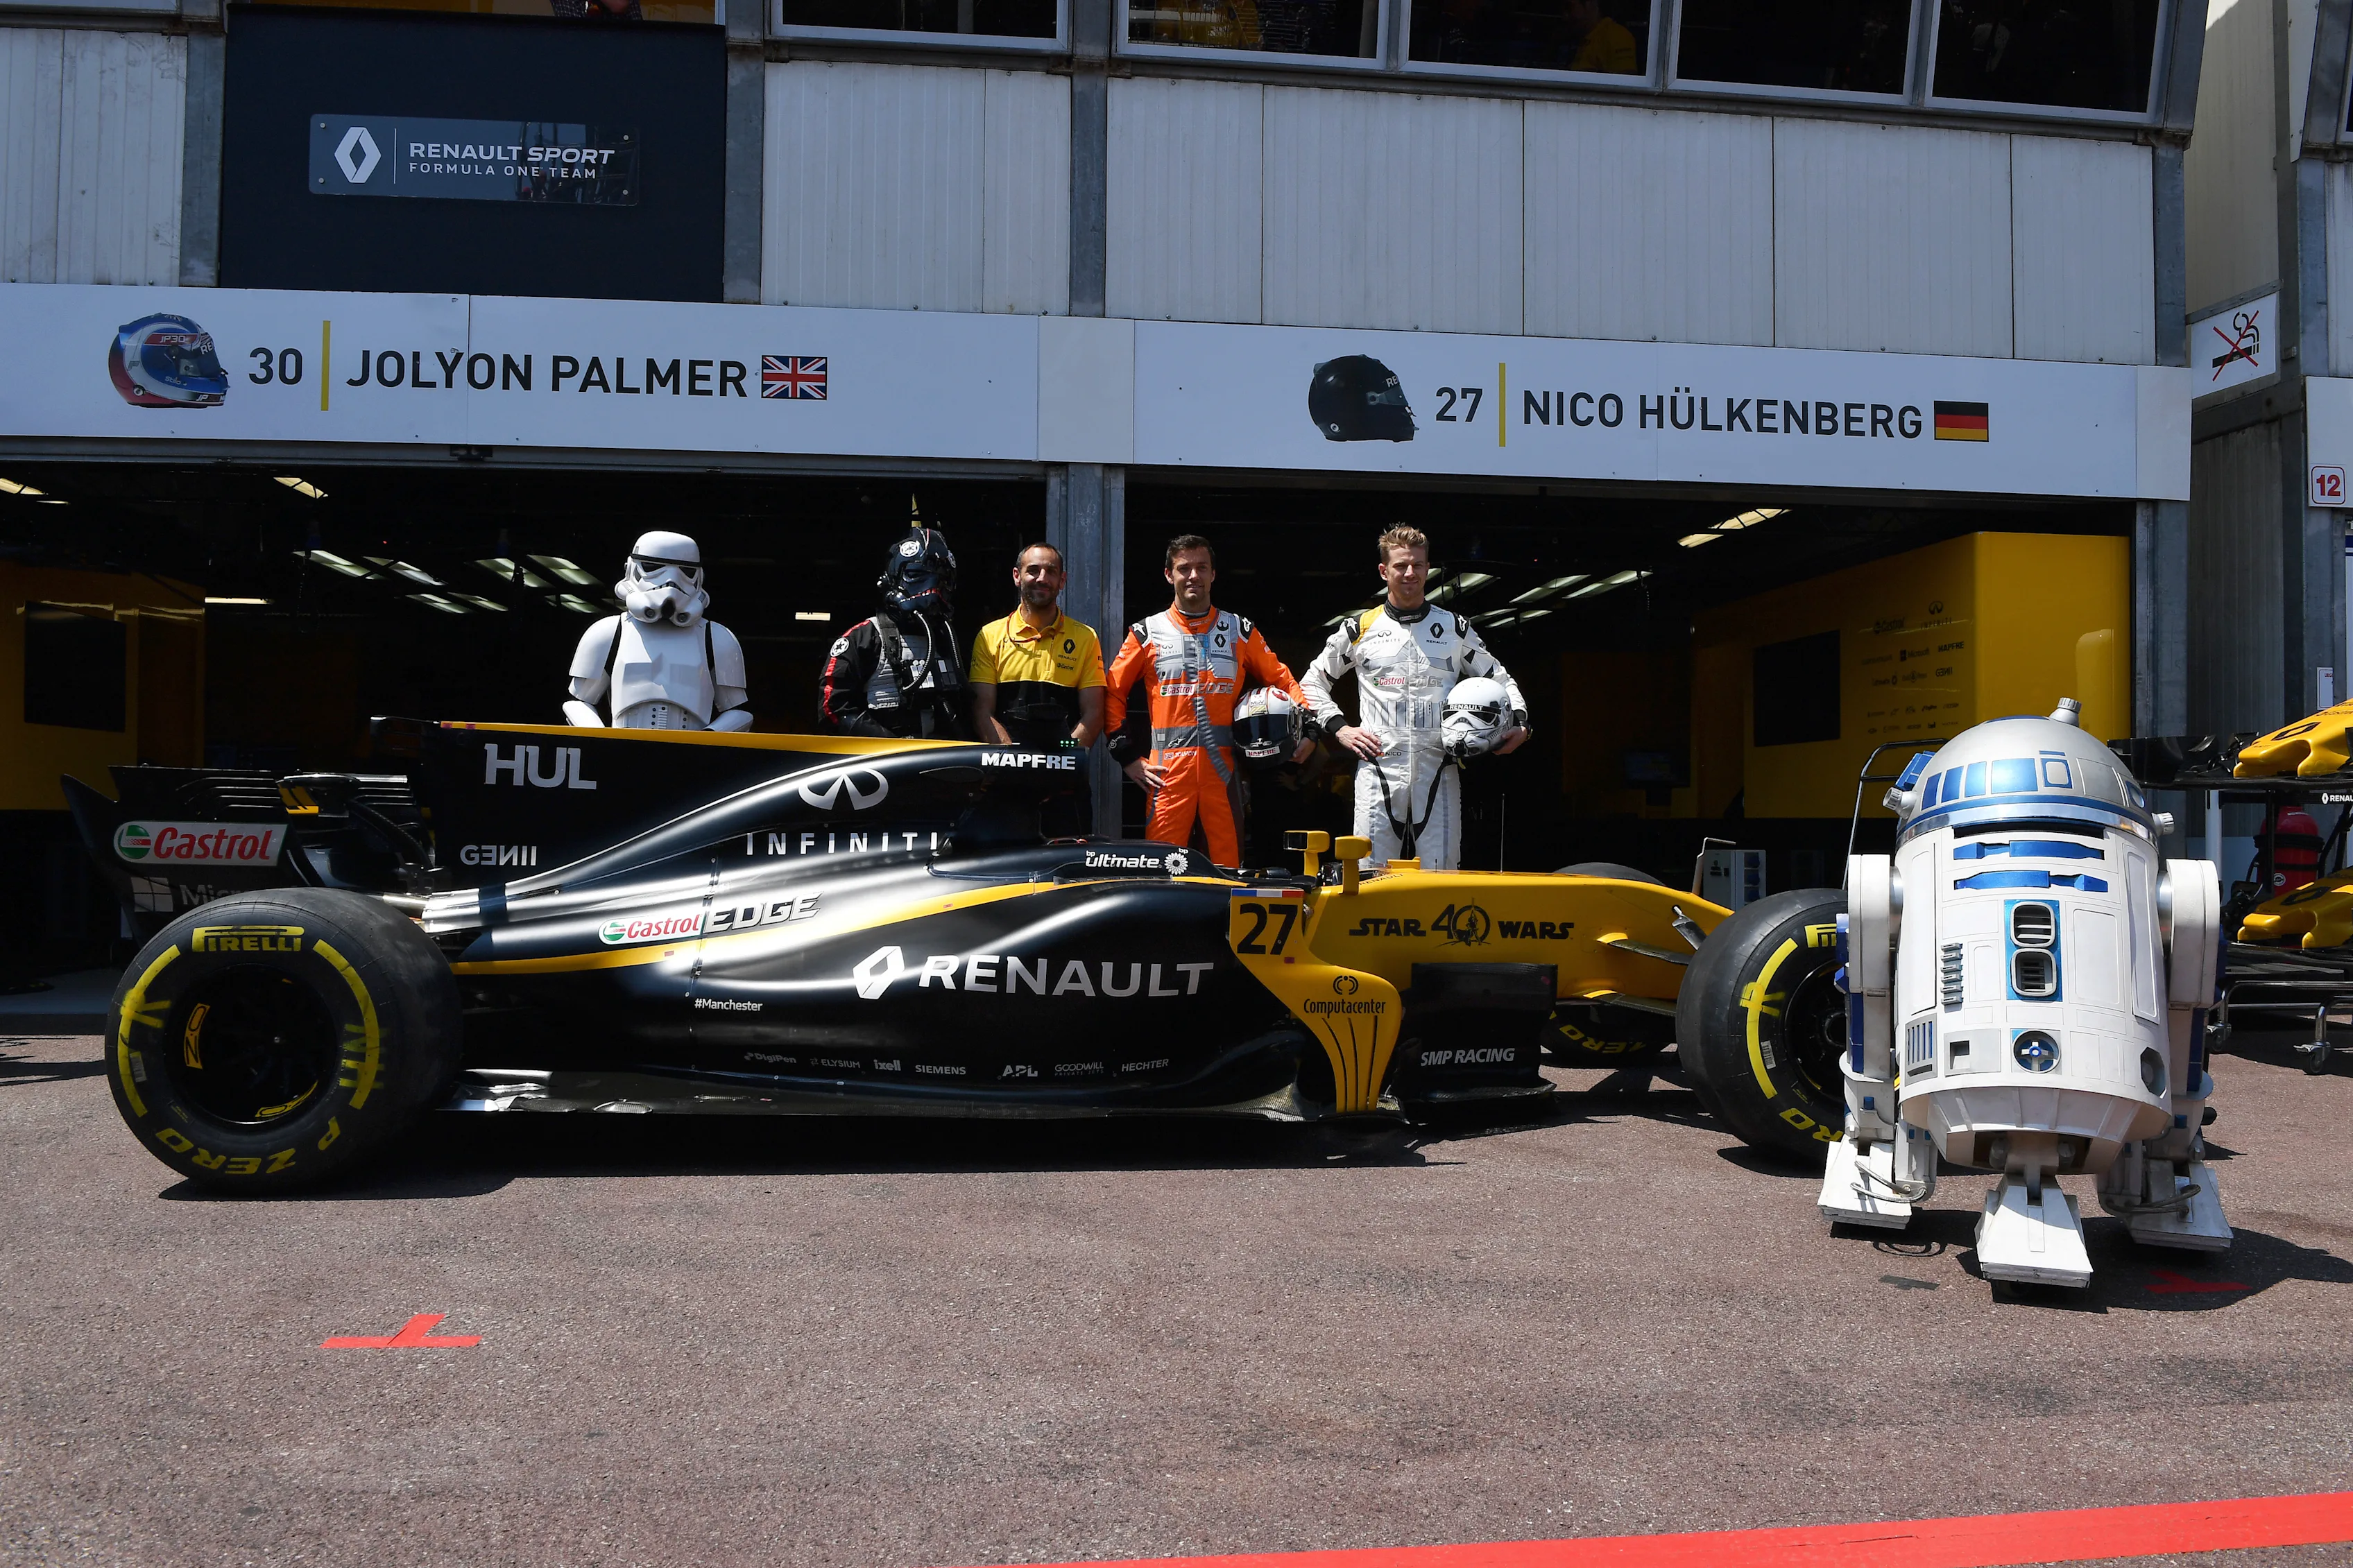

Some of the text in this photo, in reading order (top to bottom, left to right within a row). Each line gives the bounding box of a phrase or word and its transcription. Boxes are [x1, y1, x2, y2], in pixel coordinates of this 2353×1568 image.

[409, 142, 615, 164] RENAULT SPORT
[409, 162, 596, 180] FORMULA ONE TEAM
[160, 335, 186, 343] JP30
[249, 347, 302, 386] 30
[346, 351, 748, 398] JOLYON PALMER
[1436, 386, 1483, 423] 27
[1523, 386, 1922, 440] NICO HÜLKENBERG
[2316, 474, 2341, 497] 12
[1938, 641, 1964, 653] MAPFRE
[1167, 682, 1234, 694] Castrol EDGE
[1379, 676, 1405, 687] Castrol
[1449, 703, 1484, 712] RENAULT
[484, 743, 597, 790] HUL
[981, 752, 1076, 770] MAPFRE
[153, 827, 273, 861] Castrol
[746, 832, 938, 856] INFINITI
[1085, 854, 1160, 868] ultimate
[627, 890, 824, 939] Castrol EDGE
[1237, 903, 1299, 956] 27
[1349, 917, 1427, 937] STAR
[1498, 921, 1575, 940] WARS
[191, 925, 305, 953] PIRELLI
[918, 954, 1215, 998] RENAULT
[694, 997, 763, 1012] #Manchester
[1303, 998, 1386, 1019] Computacenter
[755, 1052, 797, 1064] DigiPen
[821, 1058, 860, 1069] ELYSIUM
[873, 1059, 902, 1071] ixell
[1054, 1062, 1104, 1072] GOODWILL
[1121, 1058, 1170, 1072] HECHTER
[1421, 1048, 1516, 1067] SMP RACING
[914, 1065, 966, 1076] SIEMENS
[1002, 1065, 1038, 1077] APL
[155, 1116, 341, 1175] P ZERO
